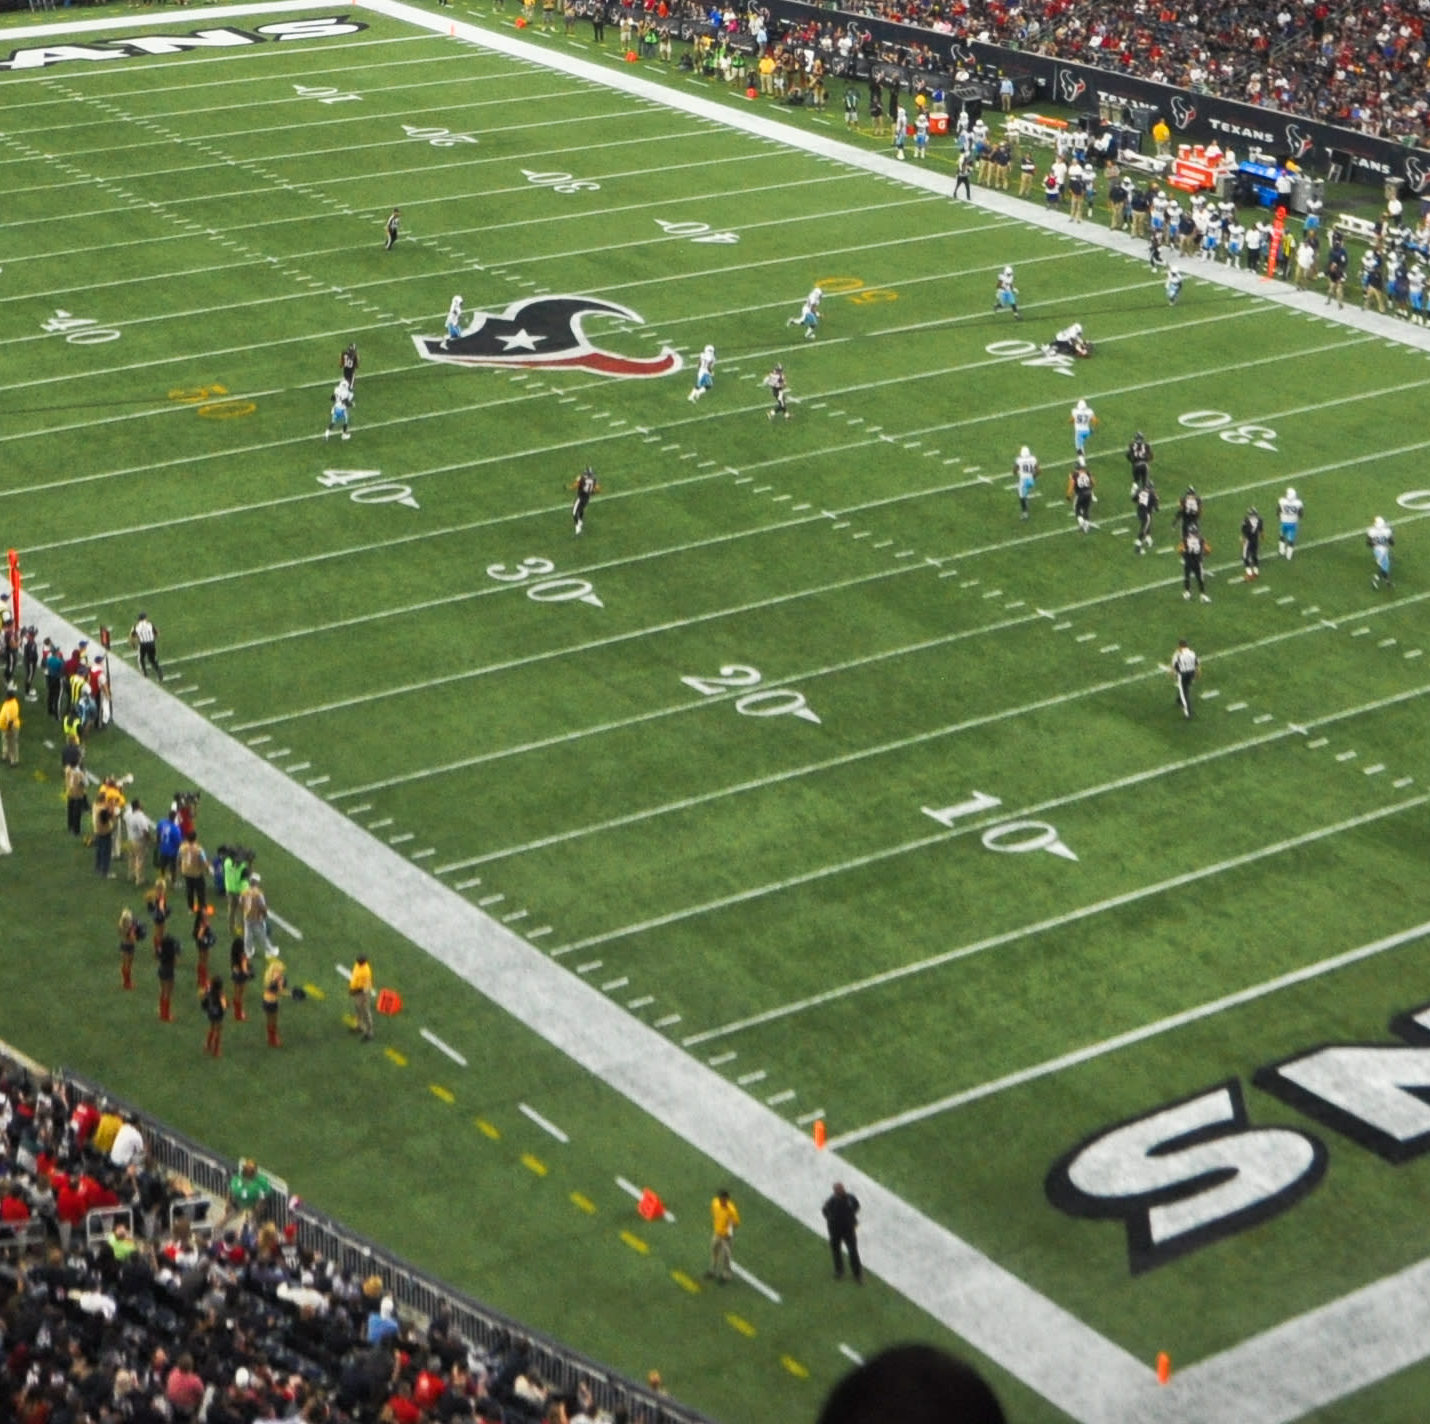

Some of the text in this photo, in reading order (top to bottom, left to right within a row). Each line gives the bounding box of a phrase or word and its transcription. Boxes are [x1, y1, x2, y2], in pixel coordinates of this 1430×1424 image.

[1208, 117, 1274, 143] TEXANS
[1177, 409, 1277, 444] 30
[315, 467, 413, 506] 40
[486, 557, 595, 605] 30
[680, 664, 806, 718] 20
[920, 789, 1059, 855] 10
